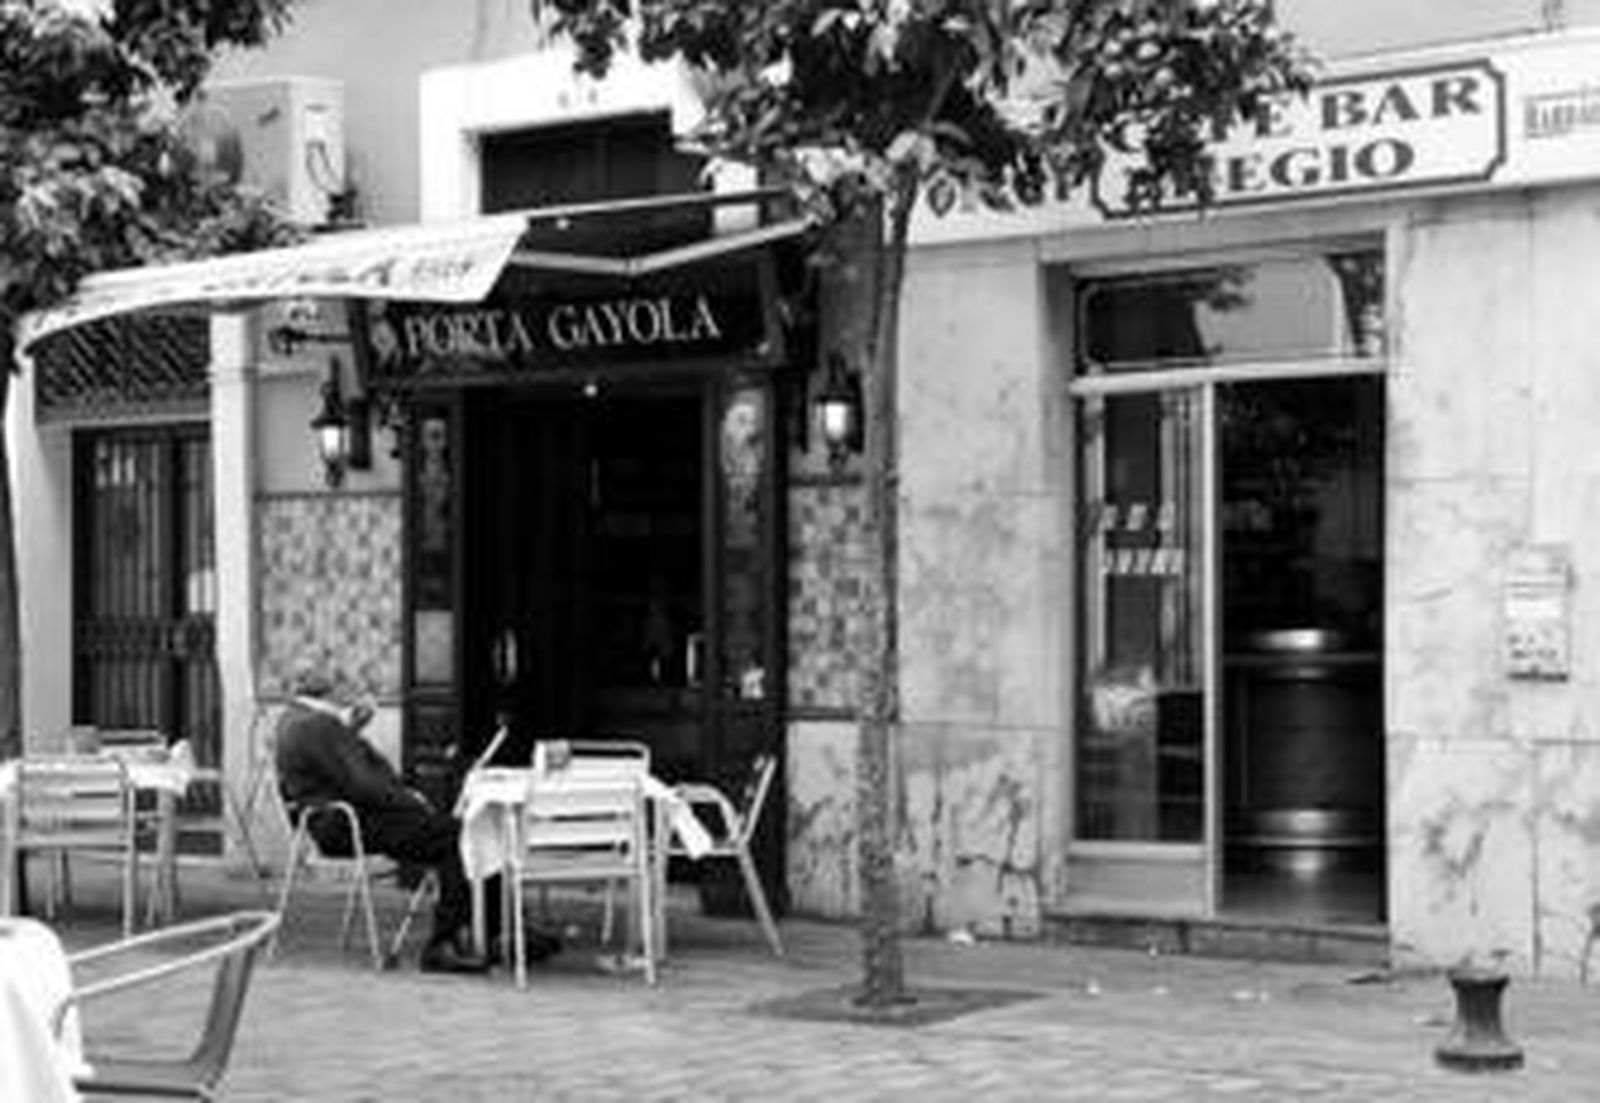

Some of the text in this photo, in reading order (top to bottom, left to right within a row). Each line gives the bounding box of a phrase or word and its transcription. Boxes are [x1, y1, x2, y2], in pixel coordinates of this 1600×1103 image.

[1322, 76, 1482, 128] BAR
[404, 297, 722, 355] PORTA GAYOLA
